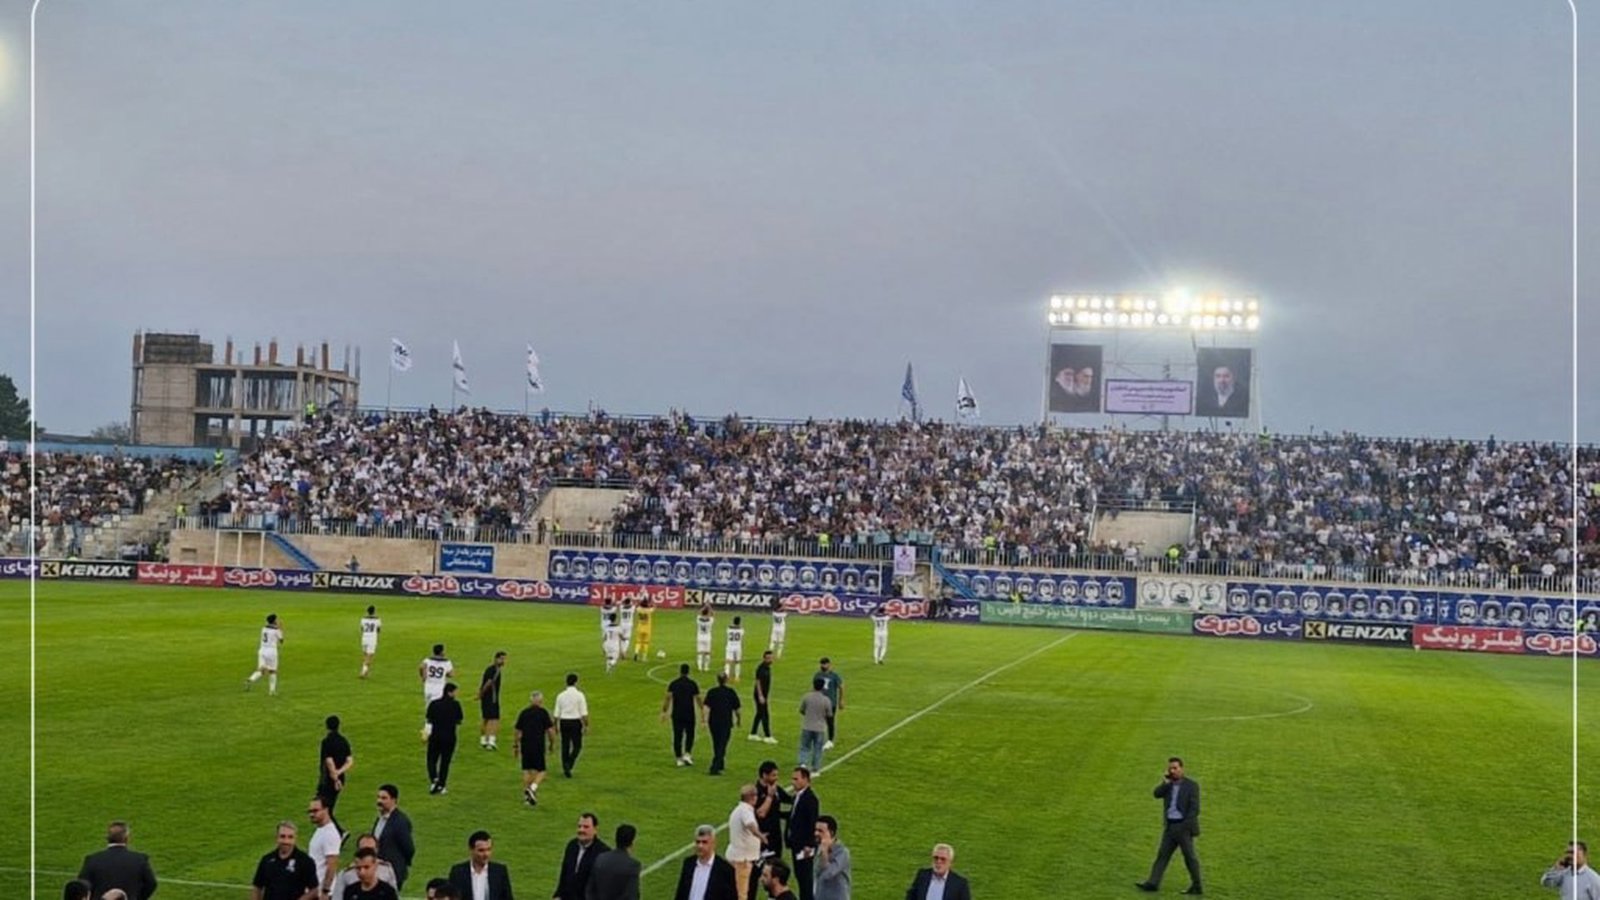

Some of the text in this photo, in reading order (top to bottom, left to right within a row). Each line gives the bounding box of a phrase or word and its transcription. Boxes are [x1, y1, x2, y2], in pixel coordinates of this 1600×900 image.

[61, 564, 131, 577] KENZAX
[330, 575, 395, 589] KENZAX
[462, 580, 494, 594] چای
[652, 586, 680, 606] چای
[703, 592, 773, 607] KENZAX
[843, 598, 877, 612] چای
[1263, 620, 1301, 636] چای
[1327, 624, 1408, 641] KENZAX
[1422, 627, 1523, 649] فیلتر یونیک
[428, 665, 445, 679] 99
